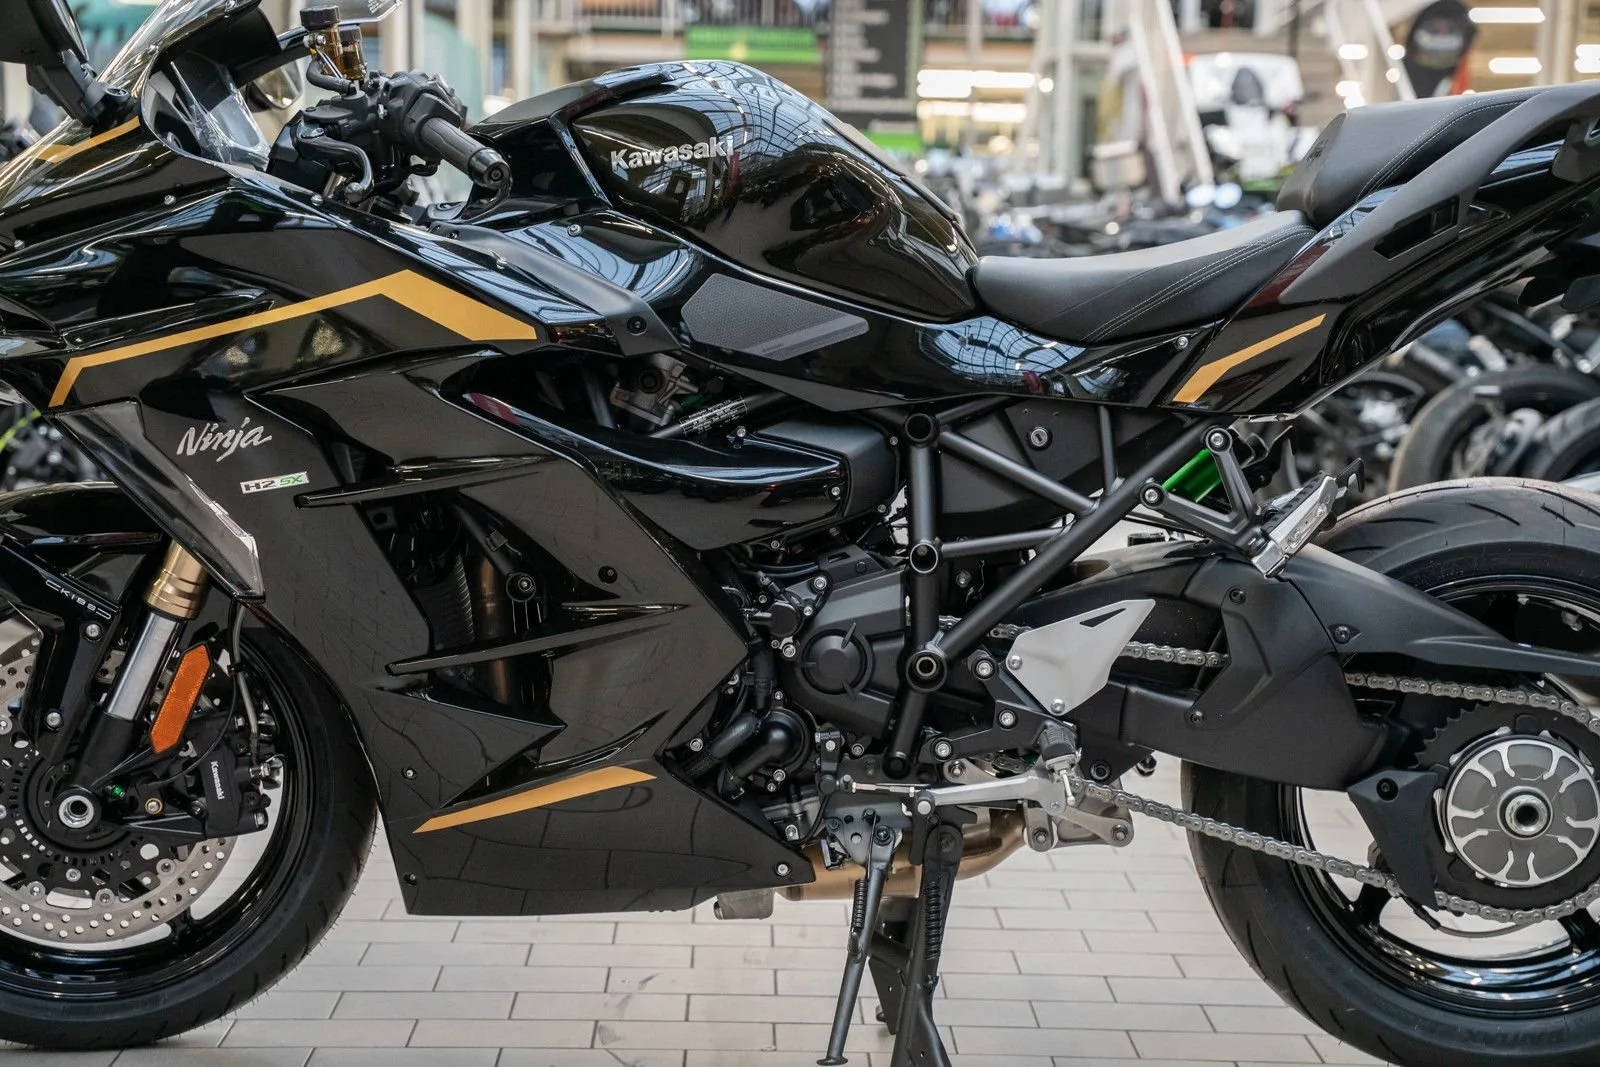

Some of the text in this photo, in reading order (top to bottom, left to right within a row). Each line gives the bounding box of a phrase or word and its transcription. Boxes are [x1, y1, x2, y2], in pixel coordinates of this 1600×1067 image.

[610, 135, 734, 169] Kawasaki
[176, 417, 272, 462] Ninja
[244, 474, 303, 492] H2 SX
[210, 760, 225, 800] Kawasaki
